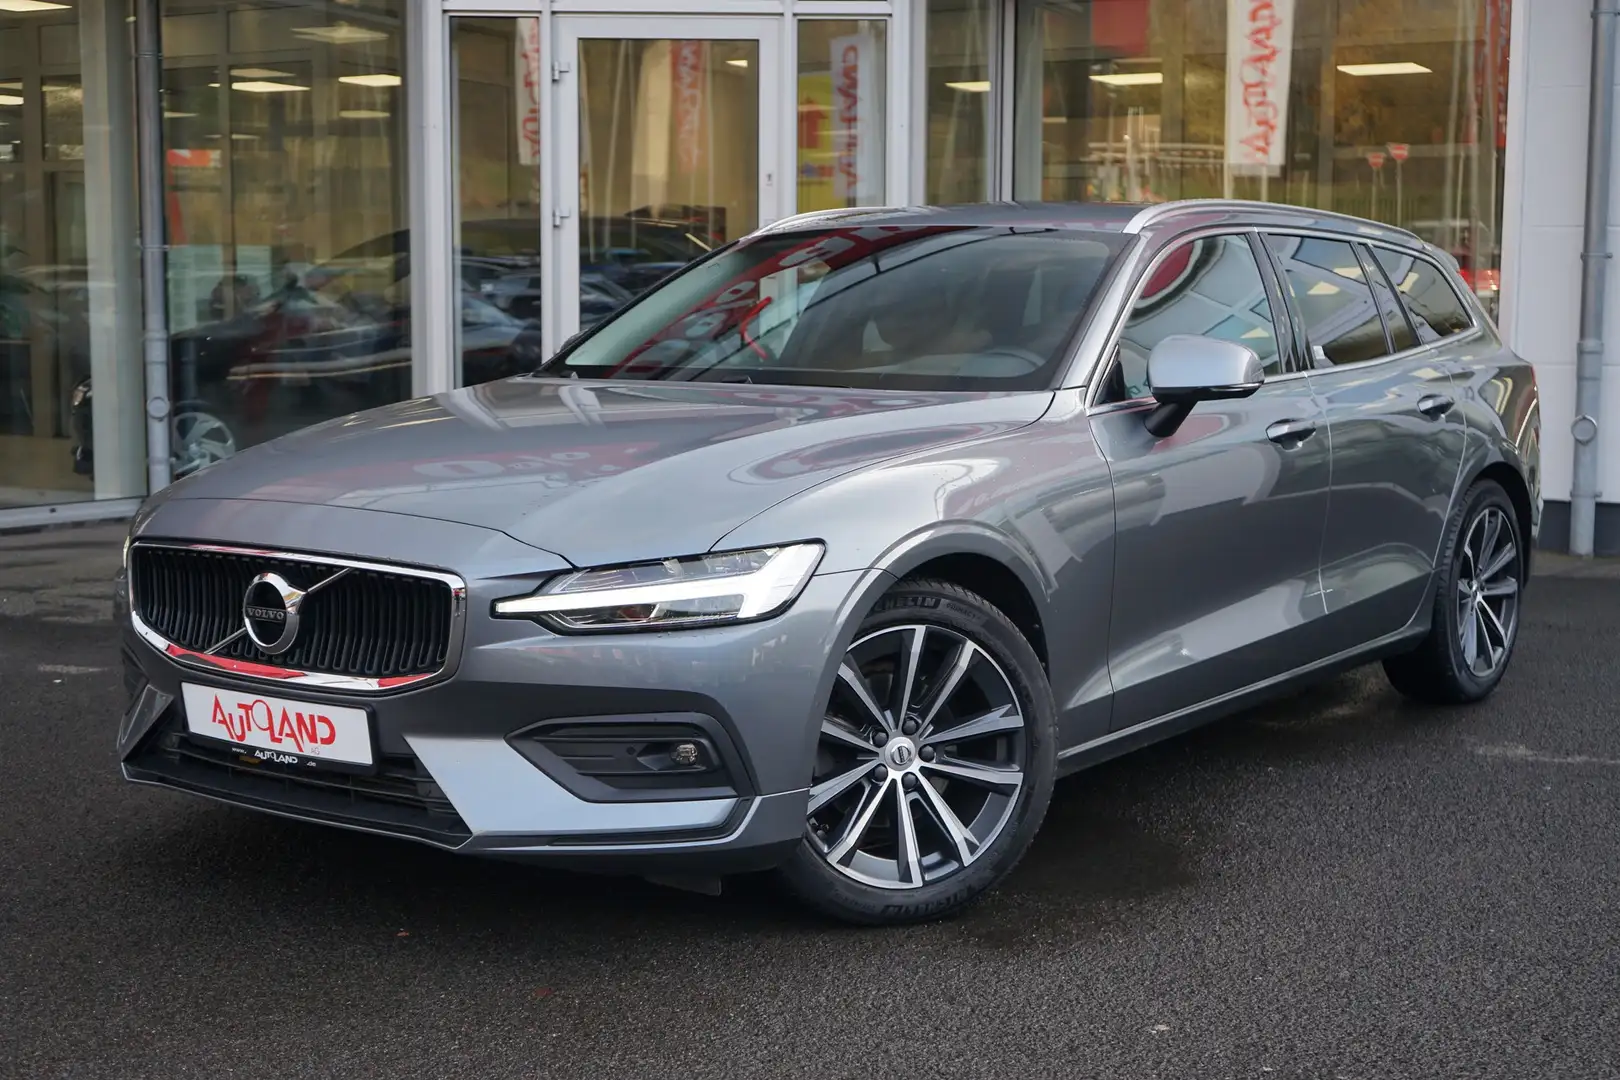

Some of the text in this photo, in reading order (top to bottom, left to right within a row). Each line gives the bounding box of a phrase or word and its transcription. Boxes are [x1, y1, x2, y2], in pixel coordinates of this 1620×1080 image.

[246, 607, 285, 620] VOLVO
[211, 693, 336, 752] AUTOLAND
[254, 749, 298, 764] AUTOLAND
